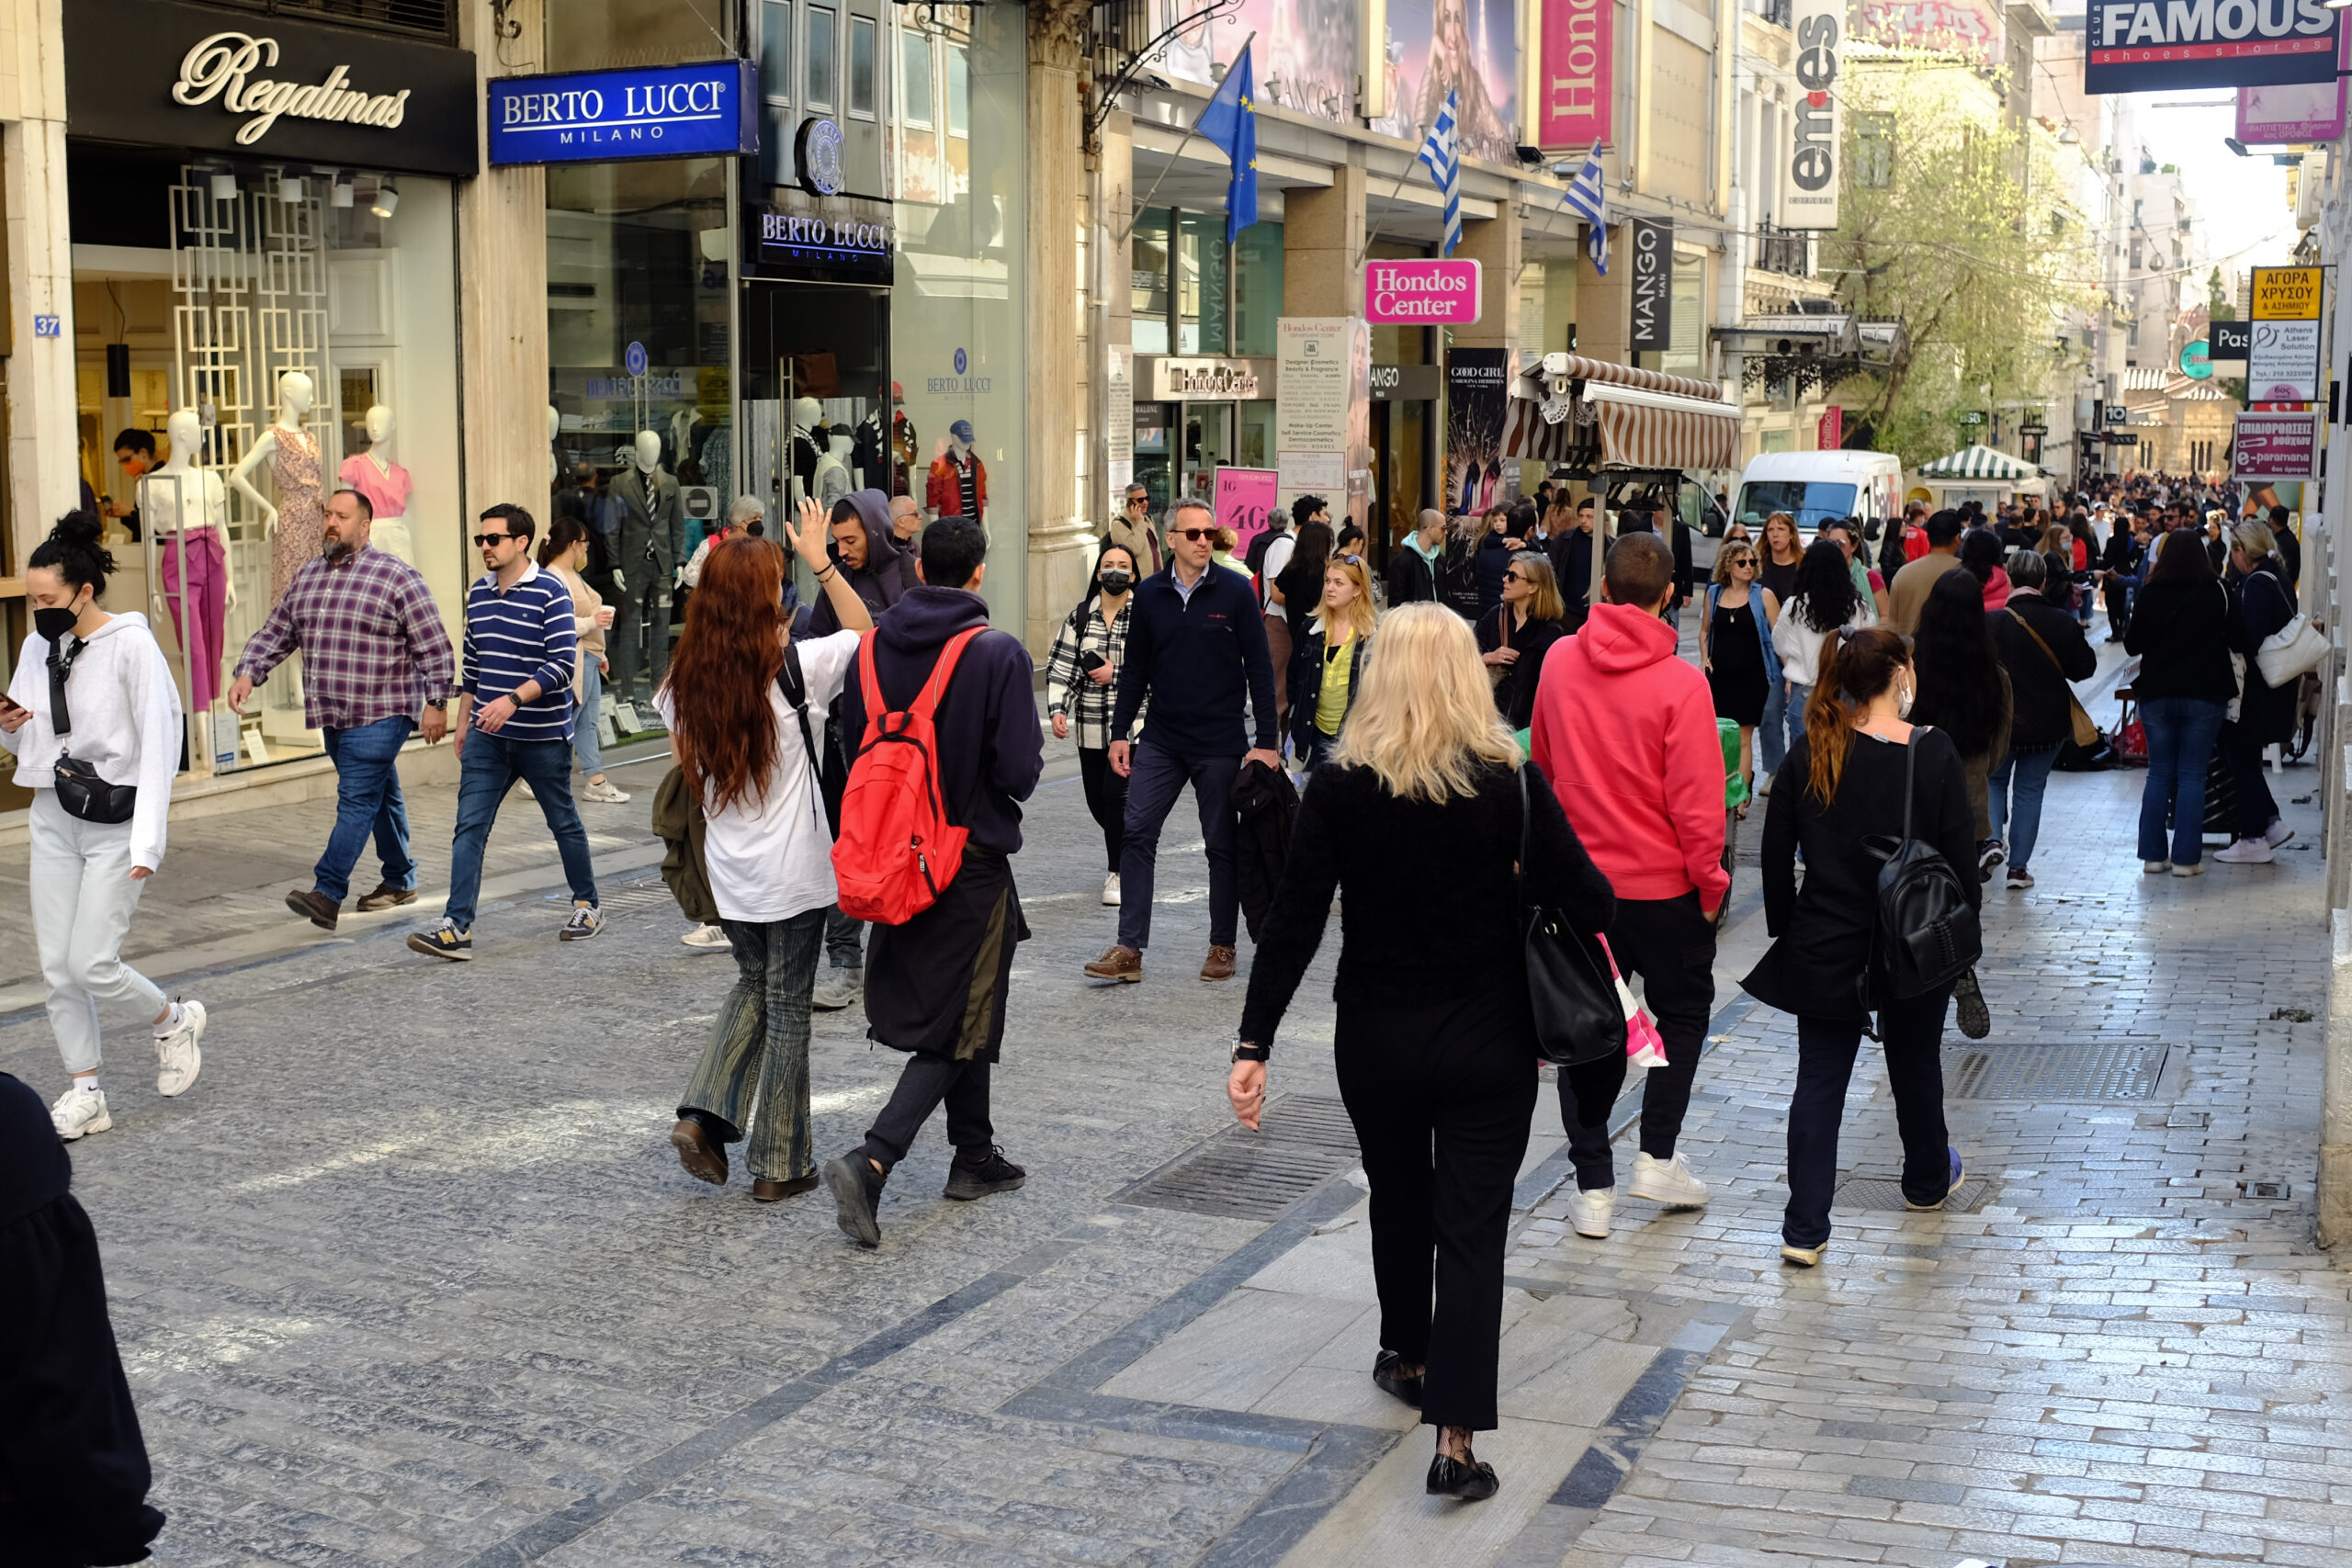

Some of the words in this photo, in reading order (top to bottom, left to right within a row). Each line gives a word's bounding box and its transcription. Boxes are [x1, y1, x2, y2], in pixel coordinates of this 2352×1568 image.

[2093, 5, 2101, 46] CLUB
[2102, 0, 2335, 46] FAMOUS
[1552, 0, 1598, 122] Hon
[2104, 50, 2190, 62] shoes
[2216, 39, 2322, 56] stores
[173, 31, 411, 145] Regalinas
[503, 88, 604, 126] BERTO
[625, 82, 723, 118] LUCCI
[560, 125, 665, 145] MILANO
[763, 214, 826, 244] BERTO
[834, 221, 886, 250] LUCCI
[792, 249, 859, 263] MILANO
[1374, 268, 1467, 293] Hondos
[1635, 228, 1657, 340] MANGO
[1658, 273, 1667, 298] MAN
[2266, 272, 2309, 285] ΑΓΟΡΑ
[2261, 287, 2313, 299] ΧΡΥΣΟΥ
[1374, 293, 1457, 316] Center
[2271, 302, 2310, 310] ΑΣΗΜΙΟΥ
[37, 317, 61, 337] 37
[1283, 323, 1313, 332] Hondos
[1315, 323, 1341, 332] Center
[1182, 367, 1224, 393] Hondos
[1224, 366, 1259, 393] Center
[1370, 367, 1399, 388] ANGO
[1451, 367, 1477, 378] GOOD
[1478, 367, 1505, 378] GIRL
[928, 378, 958, 392] BERTO
[965, 378, 990, 391] LUCCI
[1135, 405, 1159, 413] MALONE
[1822, 408, 1835, 450] chillbox
[2238, 423, 2312, 434] ΕΠΙΔΙΟΡΘΩΣΕΙΣ
[2272, 435, 2311, 446] ρούχων
[2237, 451, 2310, 465] e-paramana
